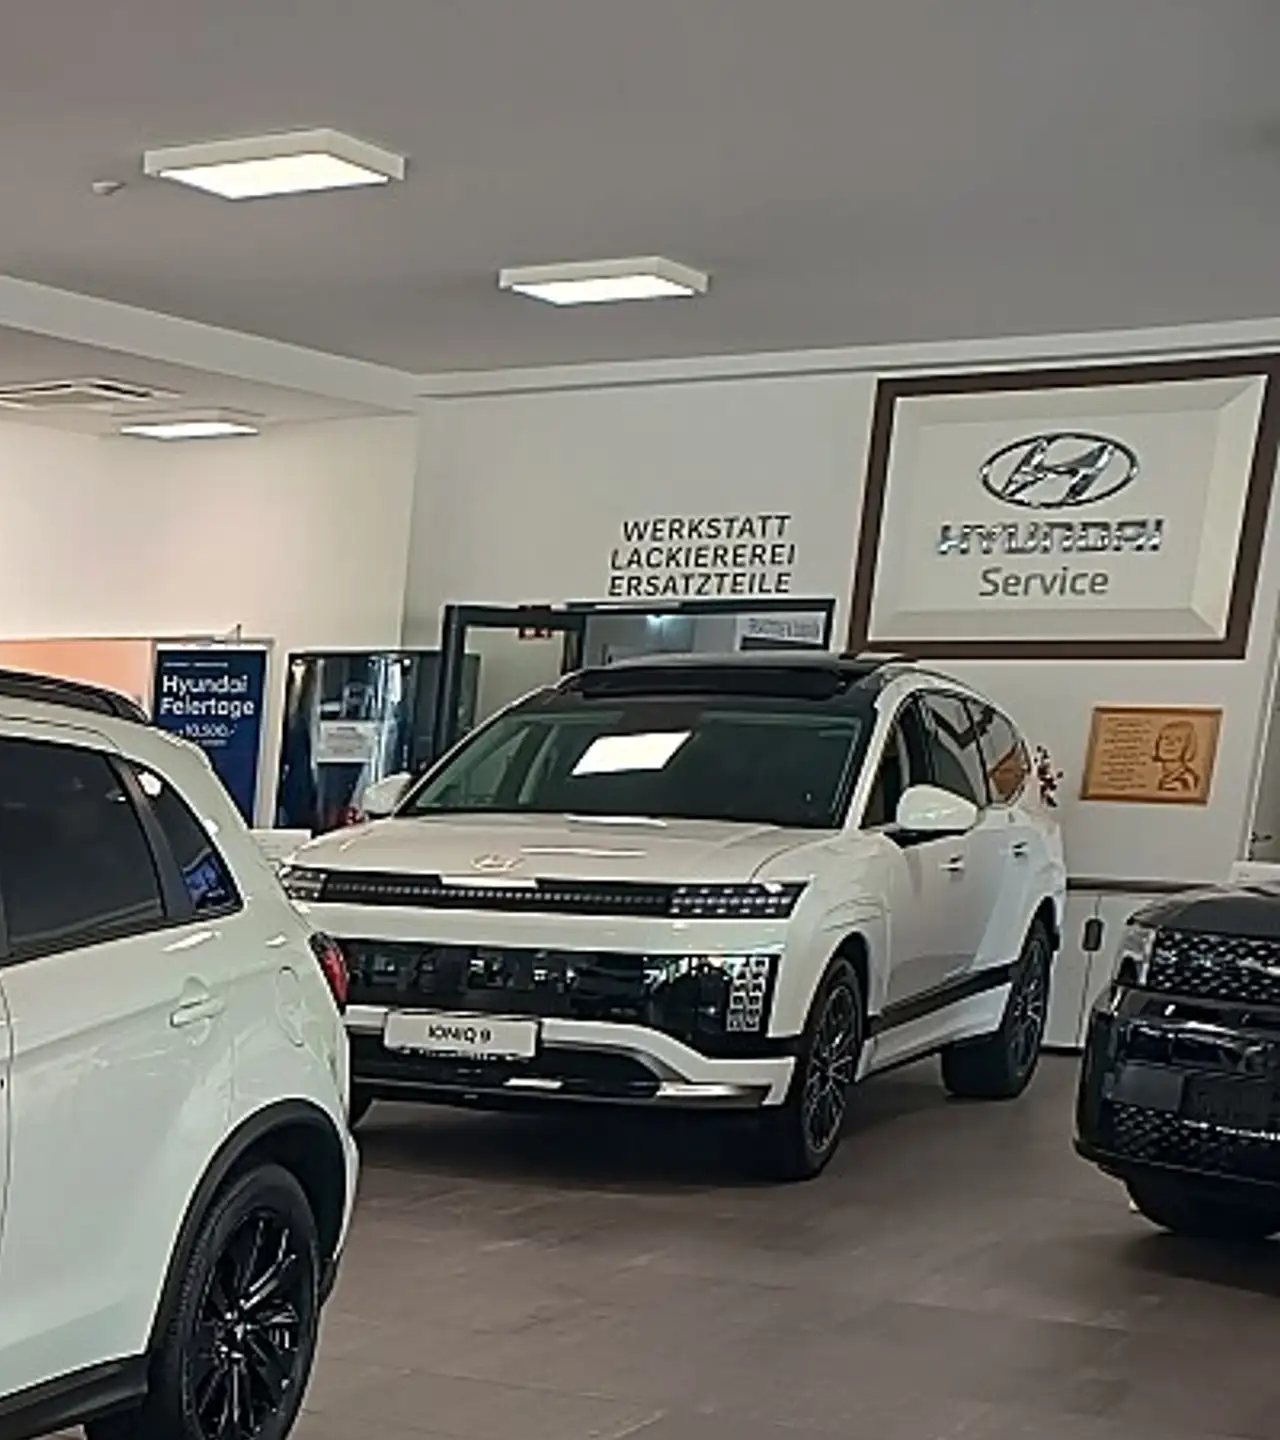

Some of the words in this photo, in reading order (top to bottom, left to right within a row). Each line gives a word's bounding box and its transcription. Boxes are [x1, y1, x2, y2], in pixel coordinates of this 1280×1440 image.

[622, 514, 792, 542] WERKSTATT
[937, 518, 1166, 556] HYUNDAI
[610, 543, 796, 571] LACKIEREREI
[607, 572, 792, 597] ERSATZTEILE
[979, 565, 1110, 598] Service
[162, 674, 248, 697] Hyundai
[159, 695, 255, 719] Feiertage
